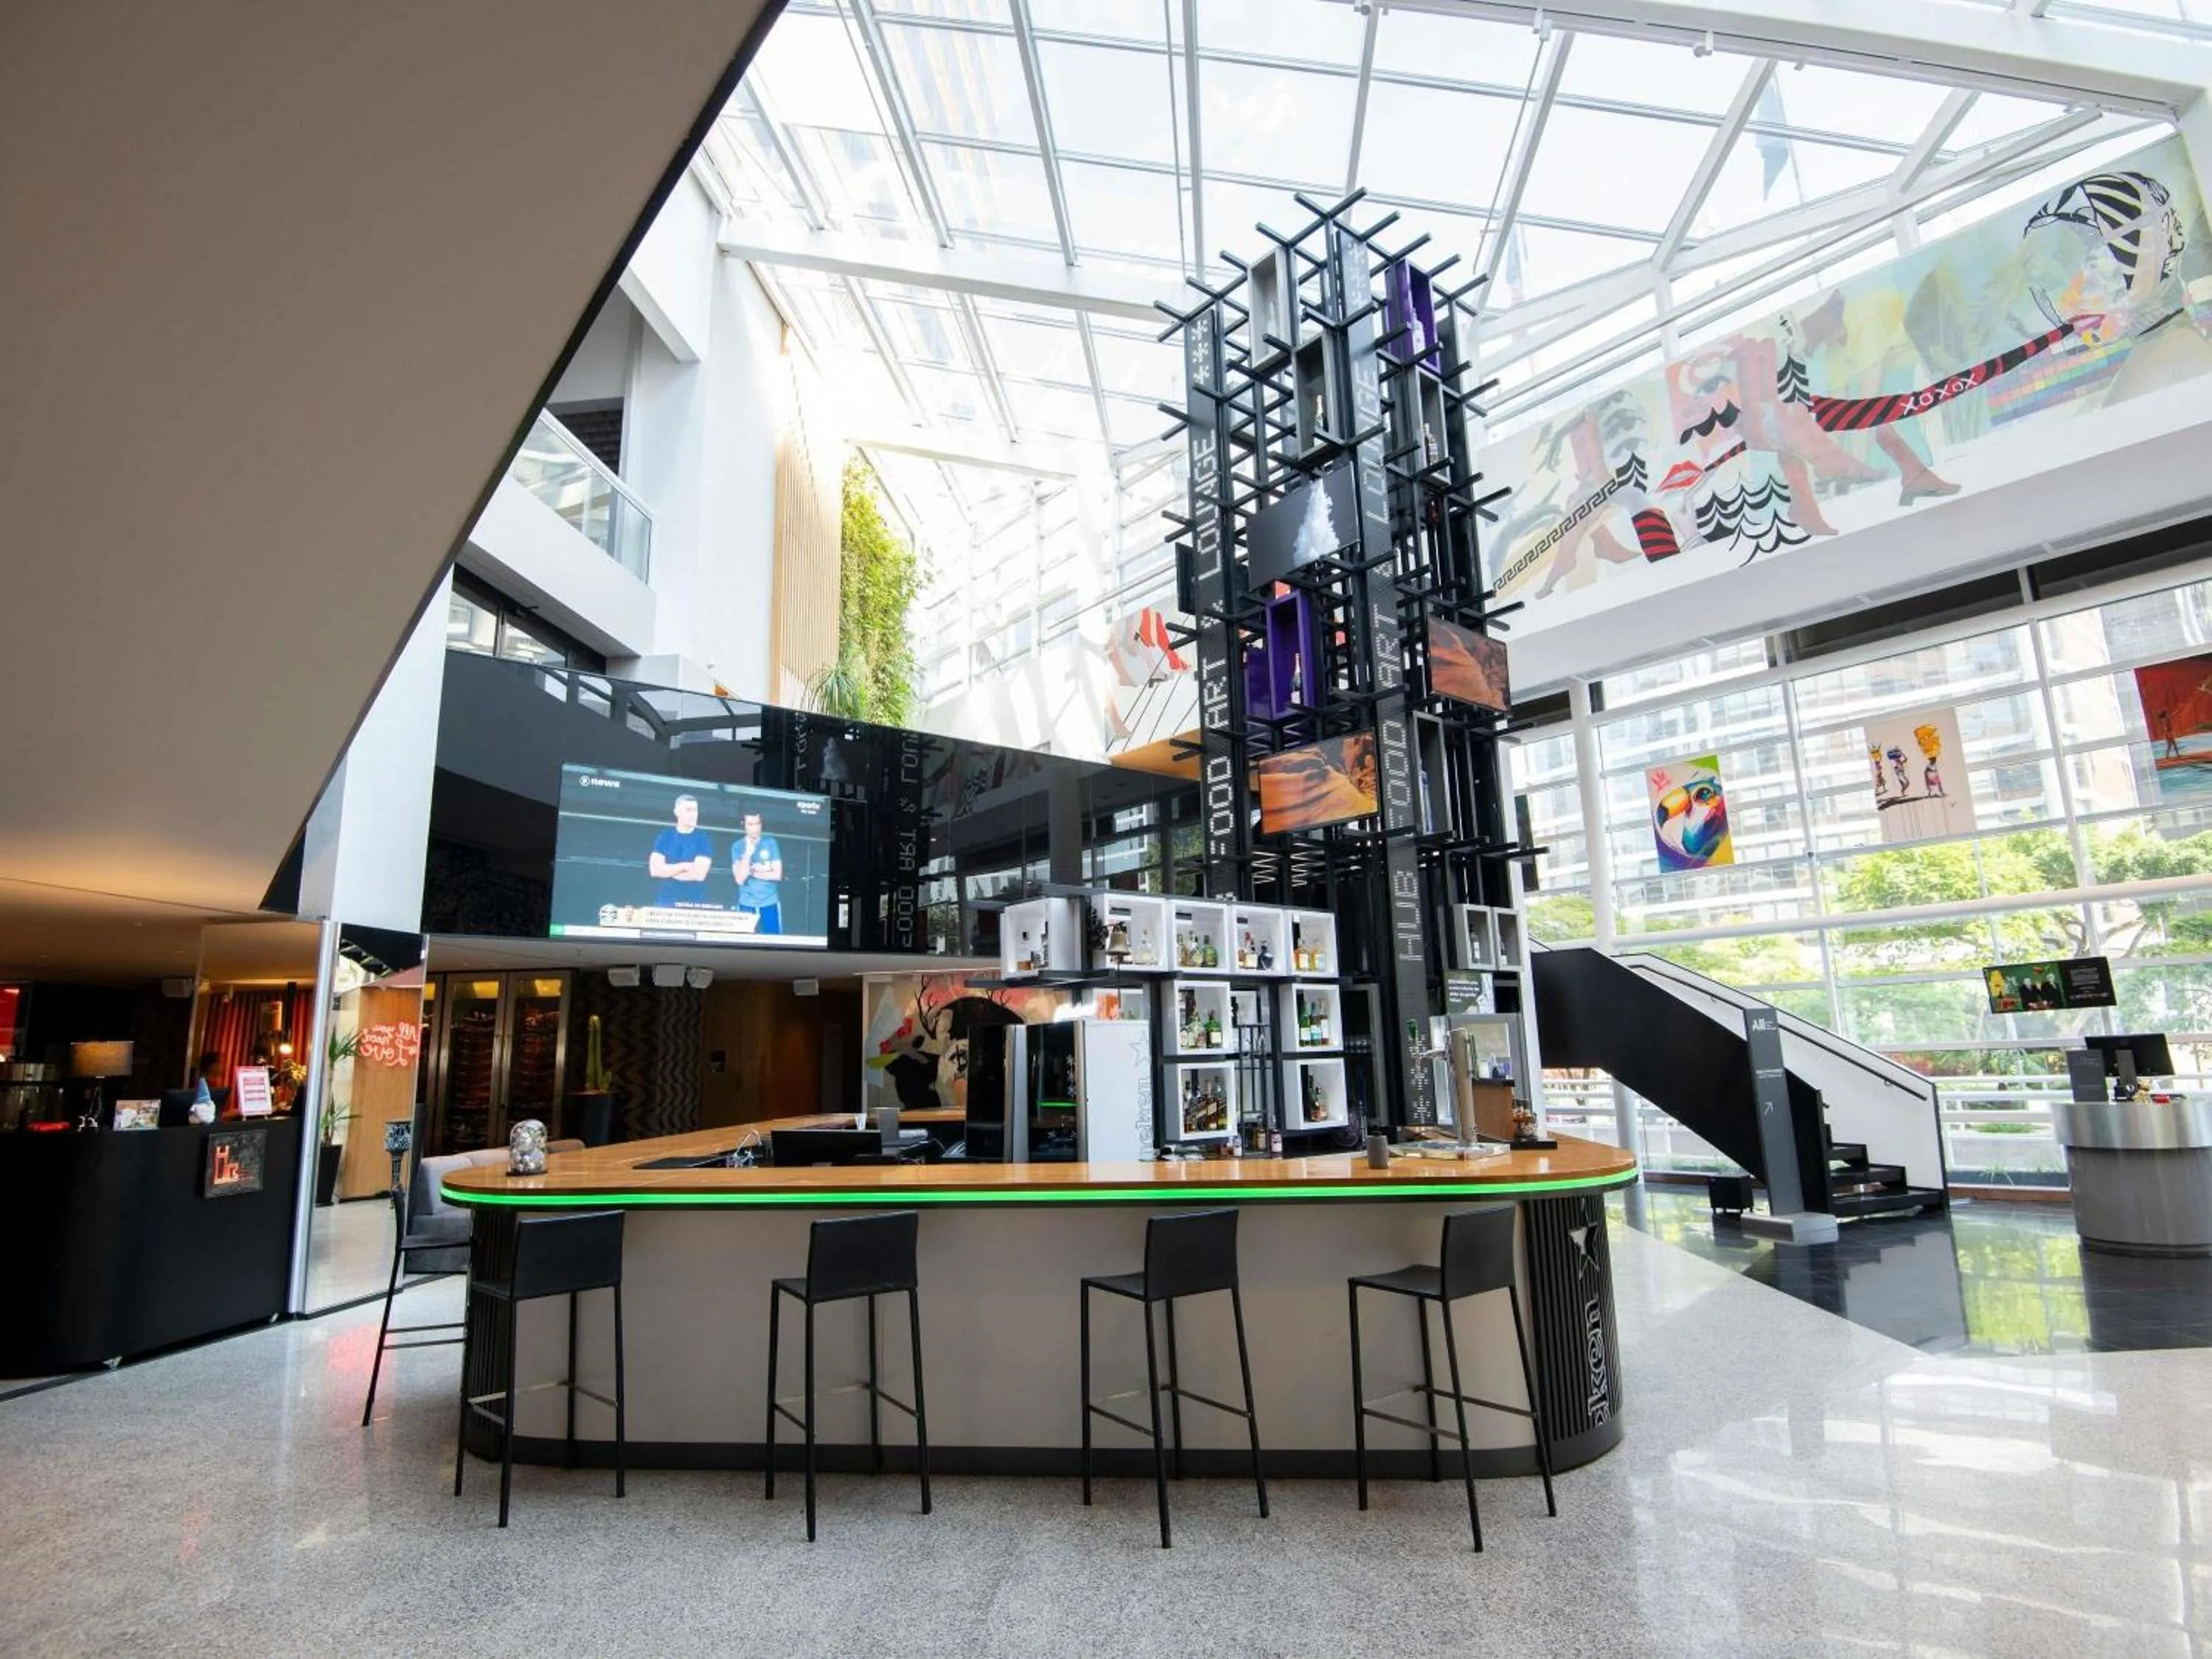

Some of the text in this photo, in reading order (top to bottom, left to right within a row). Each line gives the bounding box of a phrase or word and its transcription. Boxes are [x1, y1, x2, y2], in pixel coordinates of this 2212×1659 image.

[1193, 428, 1222, 582] LOUNGE
[1374, 604, 1401, 687] ART
[1203, 658, 1230, 731] ART
[591, 778, 620, 788] news
[1208, 755, 1235, 864] FOOD
[1382, 720, 1414, 838] FOOD
[1394, 870, 1422, 961] HUB
